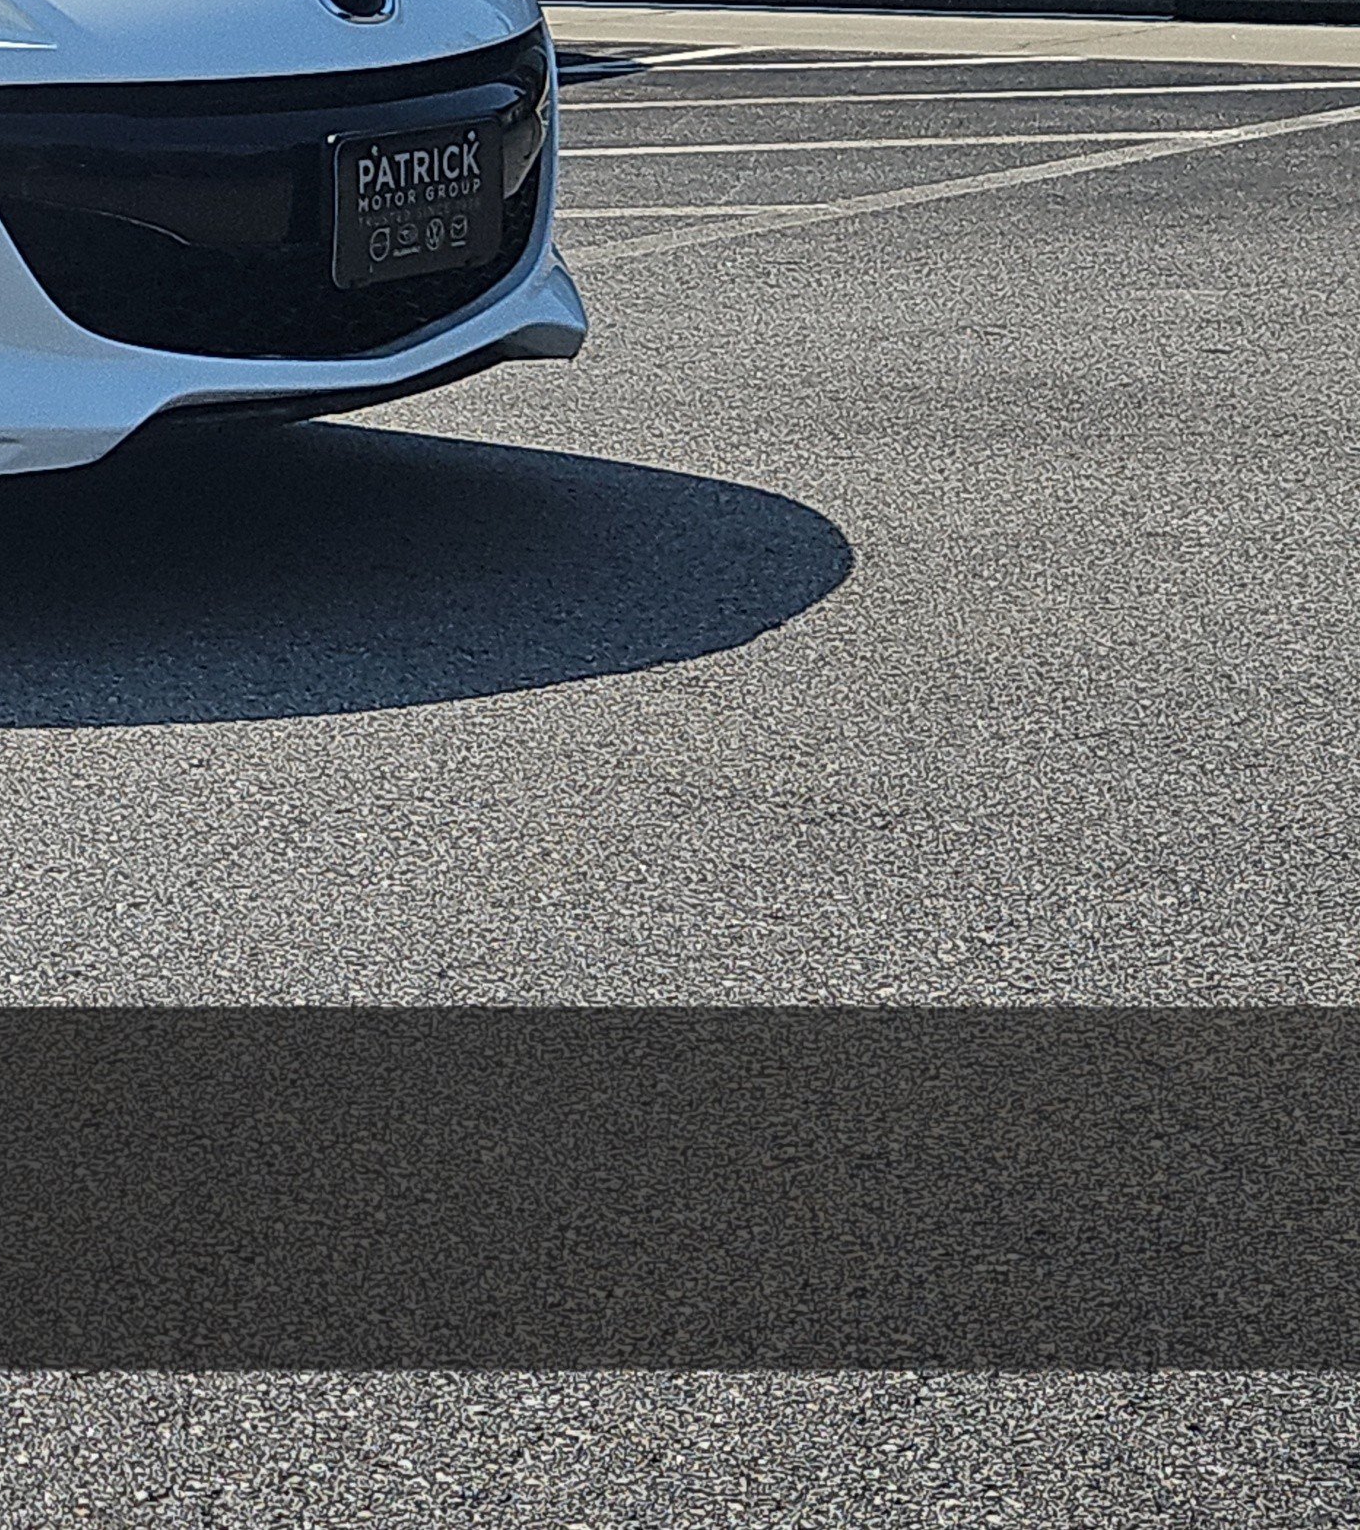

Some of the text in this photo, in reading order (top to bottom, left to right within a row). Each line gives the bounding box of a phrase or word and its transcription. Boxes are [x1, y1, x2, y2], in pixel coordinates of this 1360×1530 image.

[358, 141, 480, 195] PATRICK
[358, 189, 417, 212] MOTOR
[425, 178, 481, 202] GROUP
